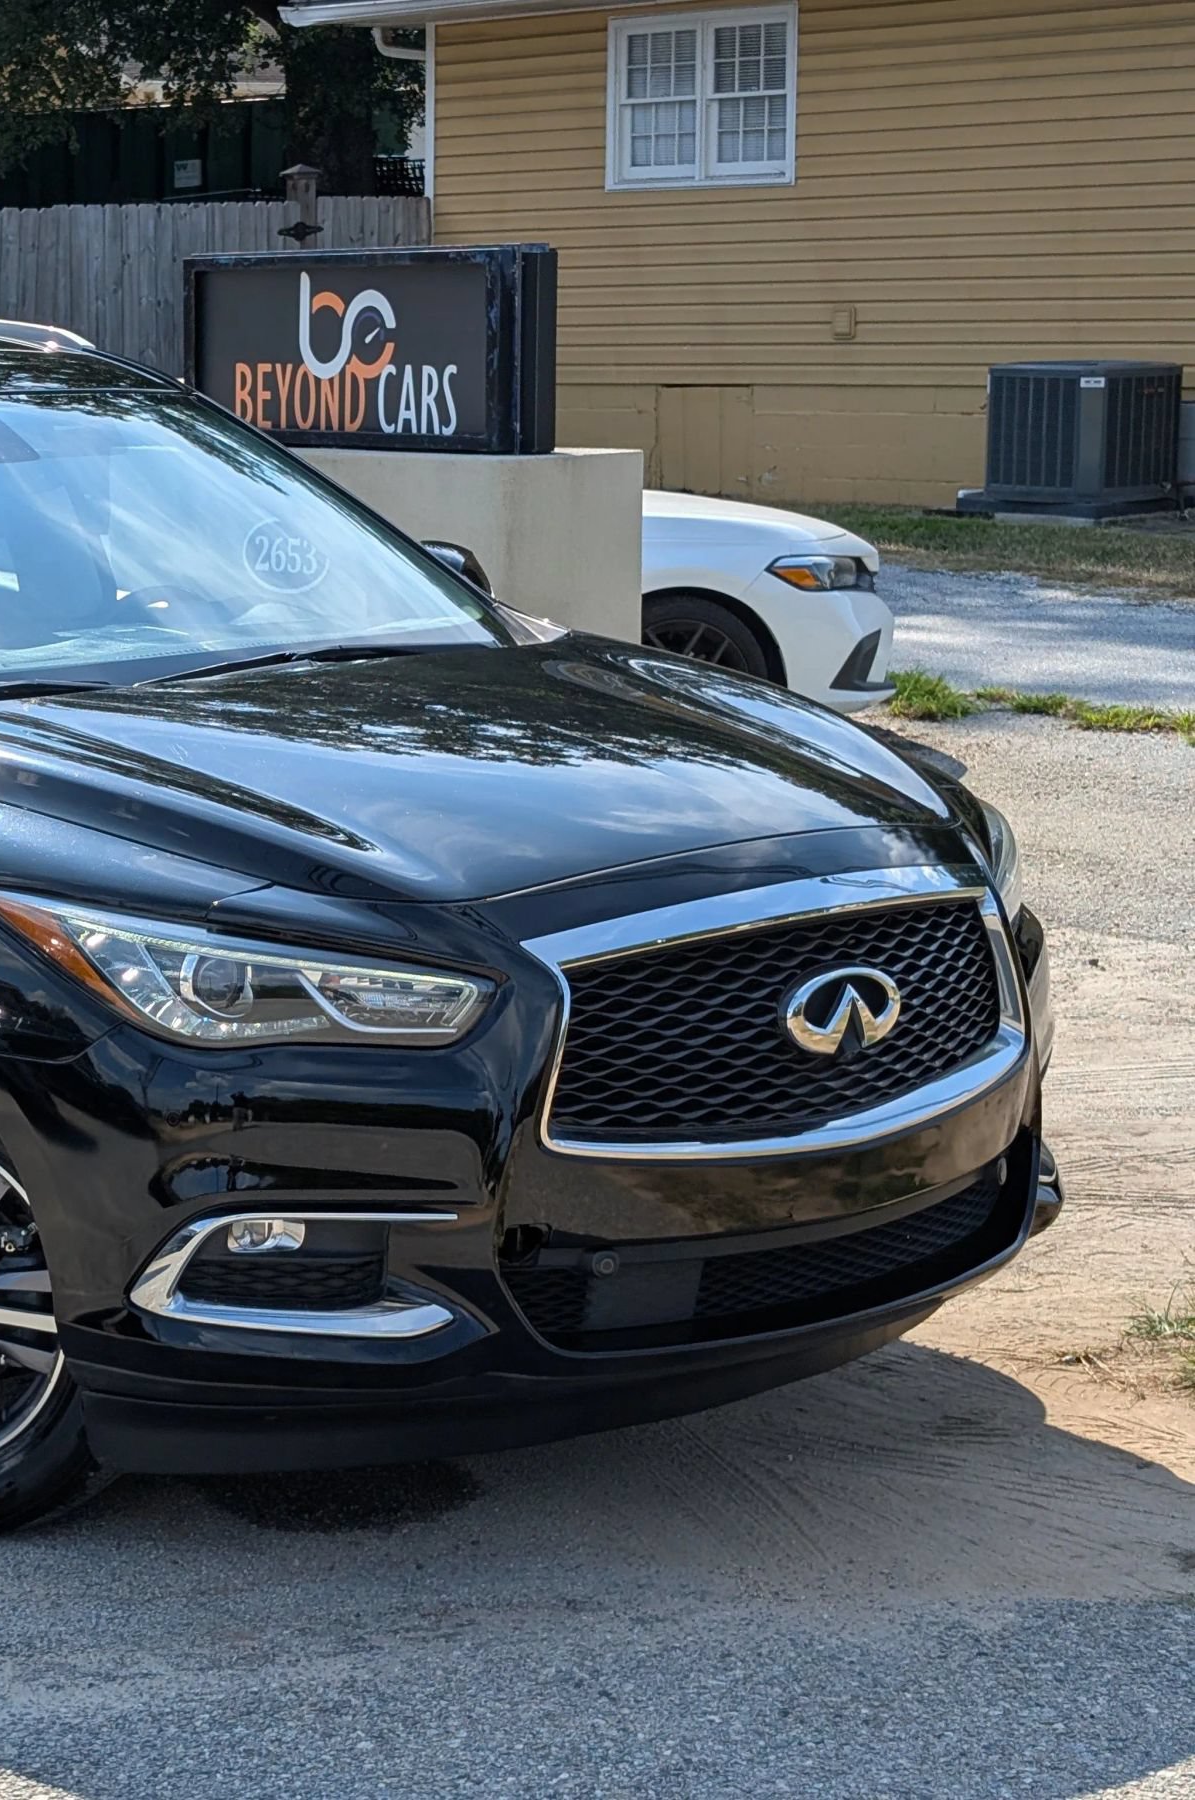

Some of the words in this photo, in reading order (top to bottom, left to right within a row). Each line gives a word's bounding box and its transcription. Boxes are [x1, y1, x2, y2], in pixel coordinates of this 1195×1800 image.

[235, 362, 366, 432] BEYOND
[378, 364, 458, 435] CARS
[254, 534, 318, 574] 2653
